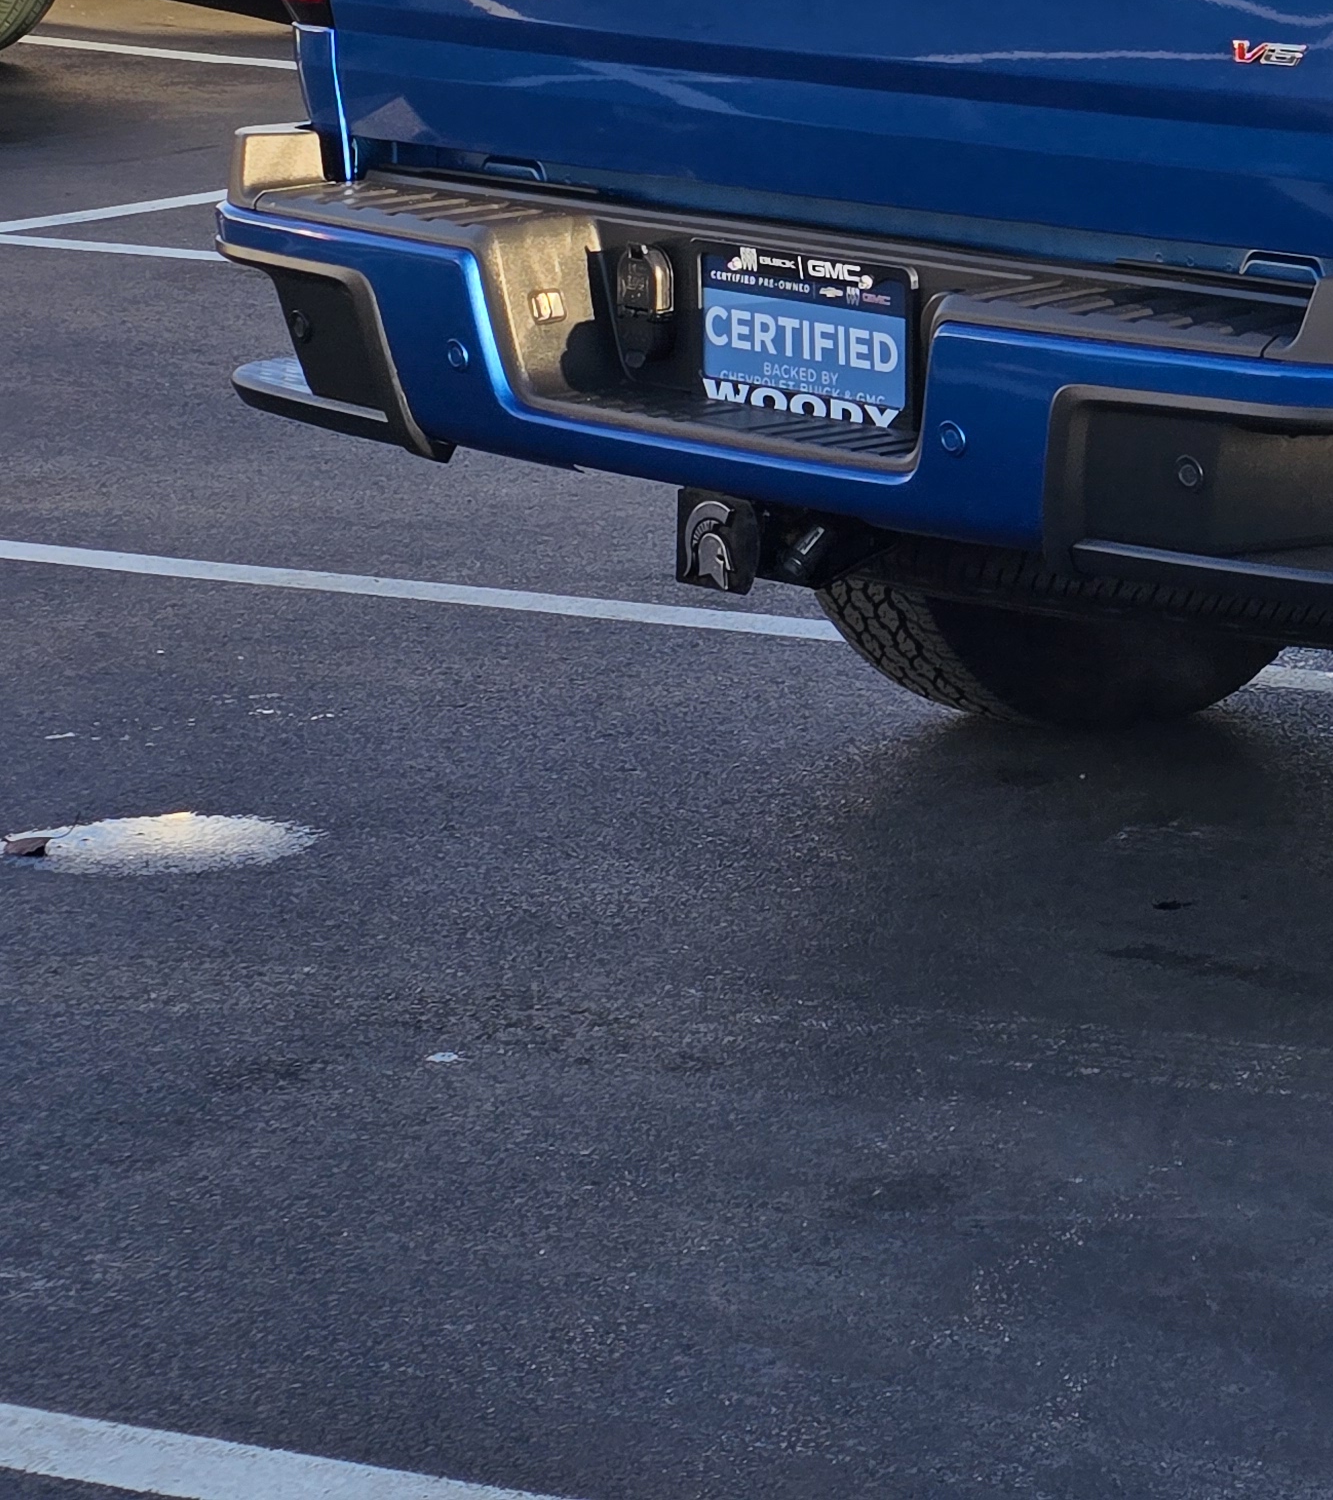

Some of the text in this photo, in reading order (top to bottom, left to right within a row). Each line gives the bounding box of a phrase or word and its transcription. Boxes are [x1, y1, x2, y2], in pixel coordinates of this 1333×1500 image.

[1232, 39, 1307, 66] V6
[710, 270, 757, 286] CERTIFIED
[758, 277, 810, 294] PRE-OWNED
[759, 256, 860, 282] BUICK GMC
[705, 306, 898, 373] CERTIFIED
[763, 362, 839, 385] BACKED BY
[702, 378, 900, 428] WOODY
